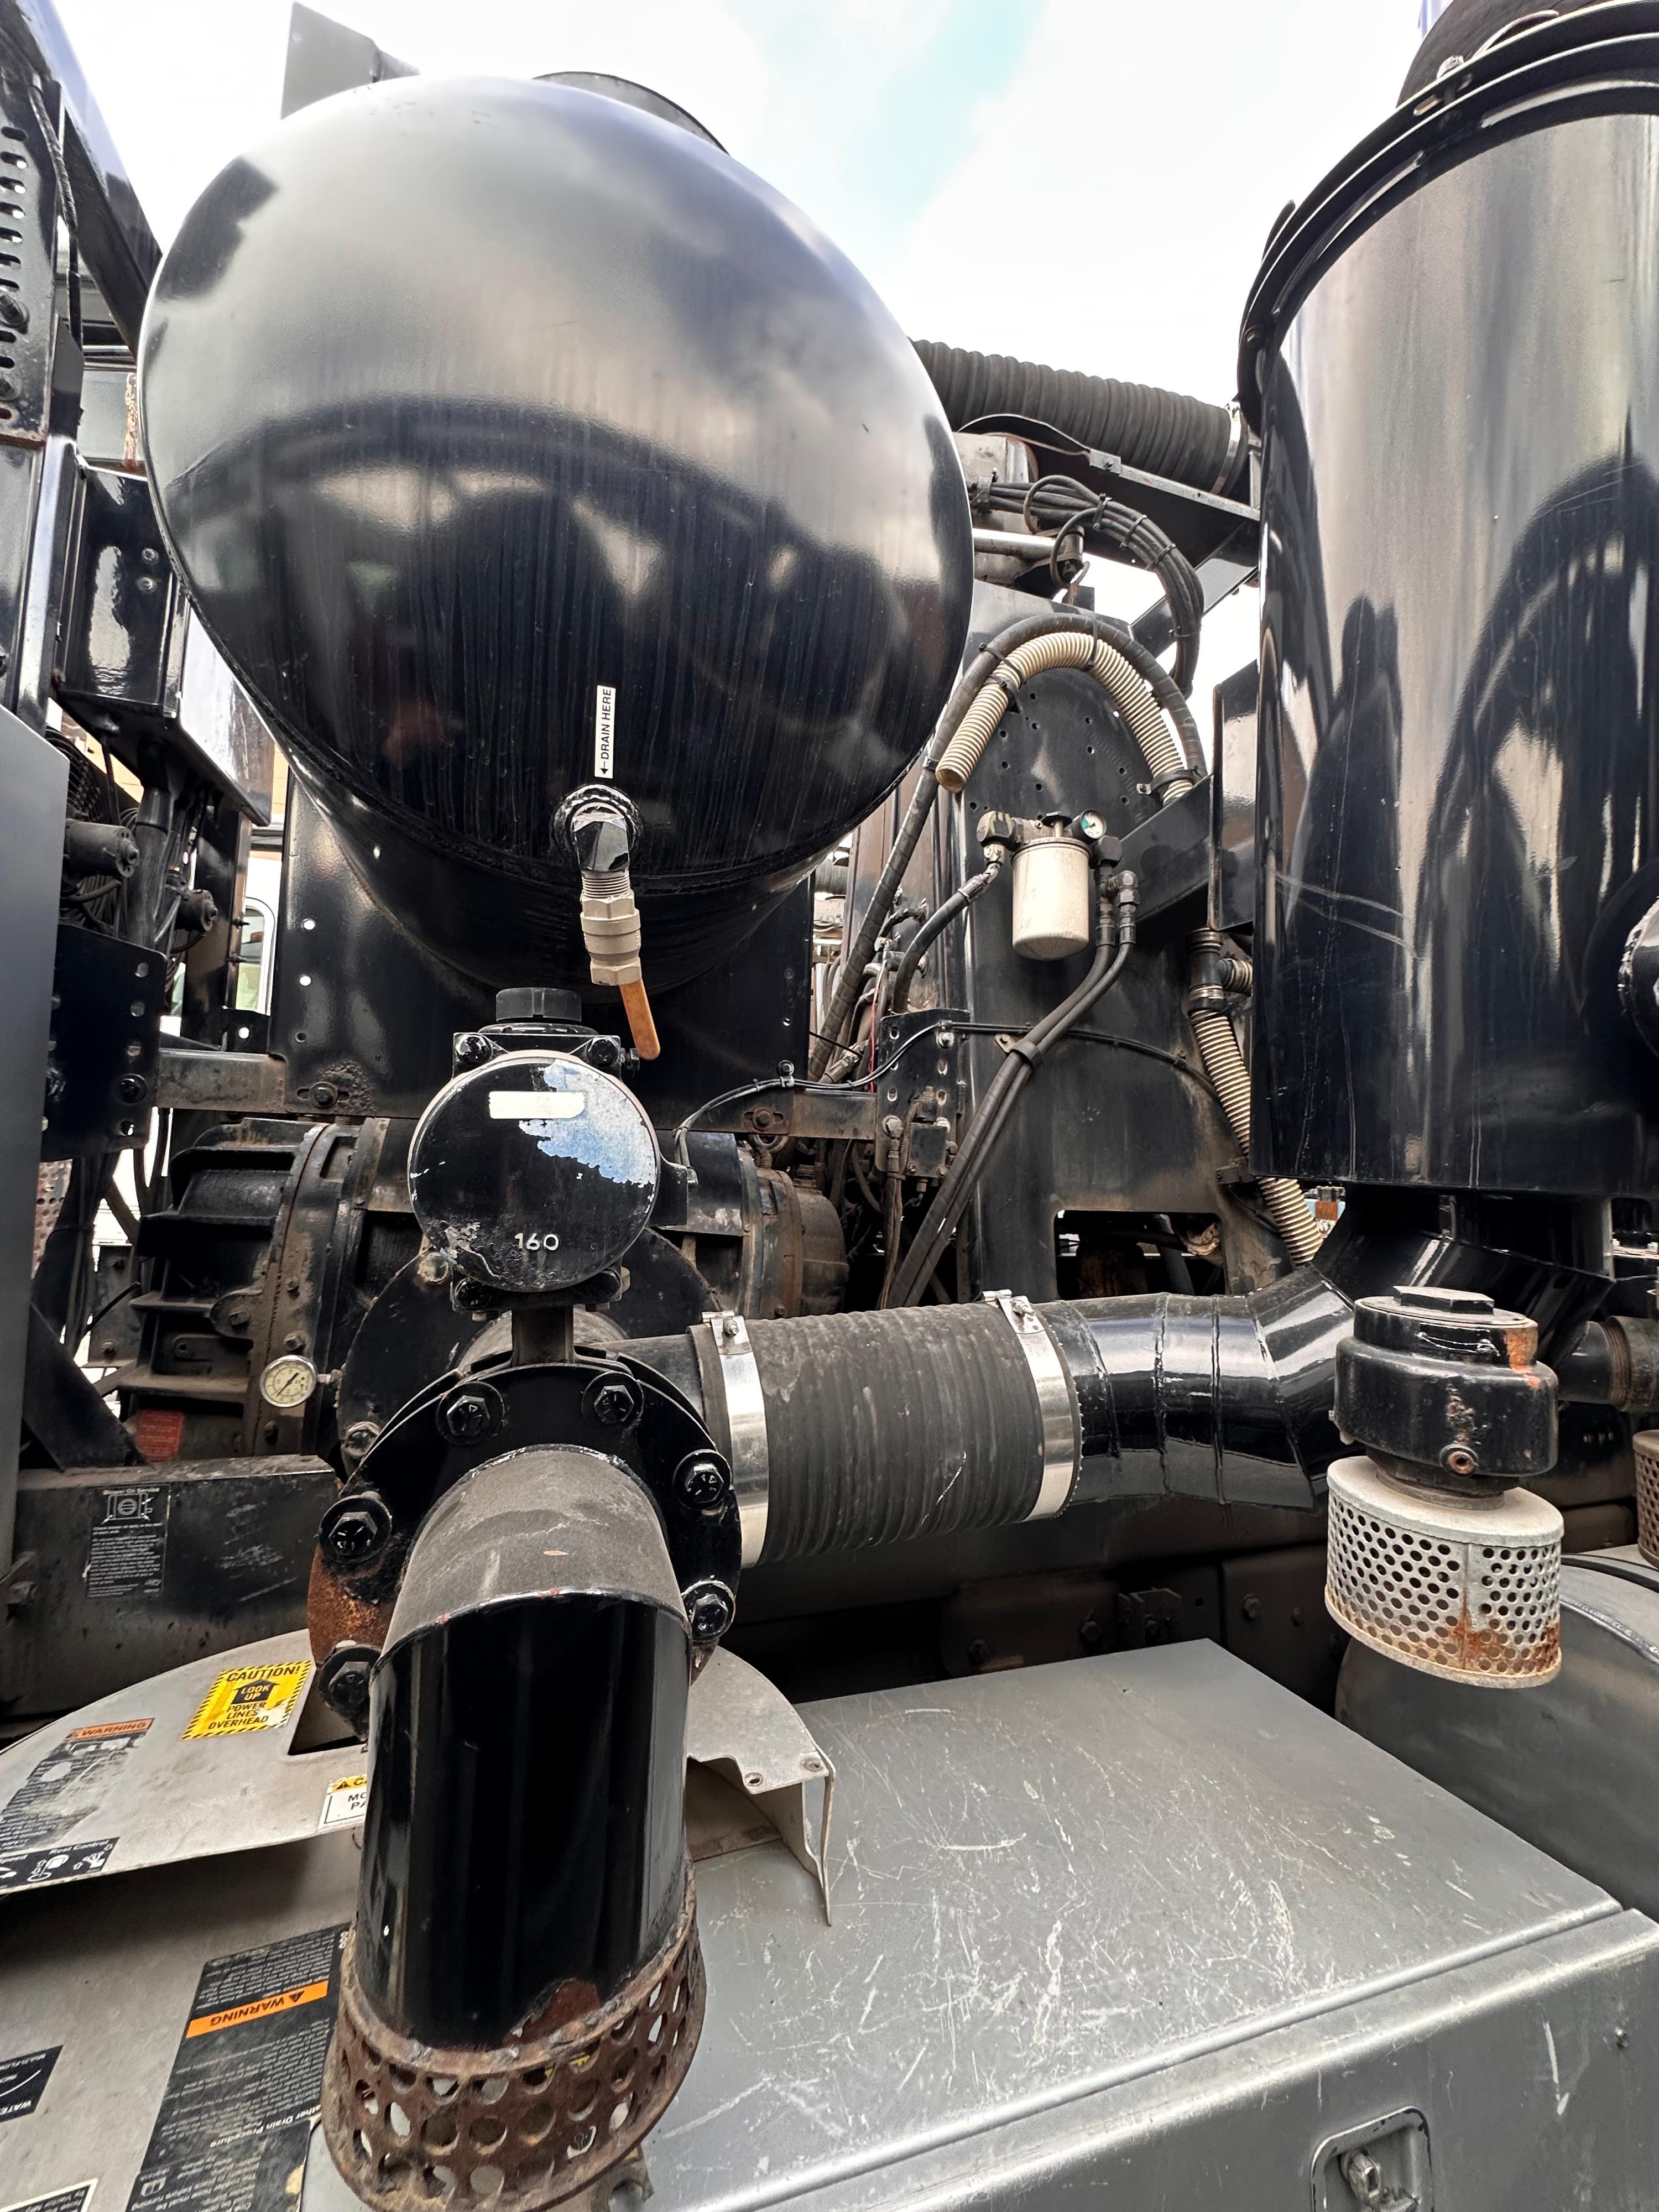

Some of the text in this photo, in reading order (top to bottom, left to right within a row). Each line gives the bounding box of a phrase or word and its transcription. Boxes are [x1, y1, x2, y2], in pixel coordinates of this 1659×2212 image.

[601, 688, 612, 760] DRAIN HERE
[514, 1233, 560, 1251] 160
[226, 1666, 301, 1682] CAUTION!
[241, 1684, 271, 1694] LOOK
[244, 1692, 262, 1701] UP
[226, 1702, 267, 1713] POWER
[227, 1709, 261, 1720] LINES
[83, 1721, 147, 1736] WARNING
[207, 1715, 269, 1730] OVERHEAD
[210, 1997, 285, 2027] WARNING
[0, 2100, 32, 2116] WATE
[210, 2104, 321, 2147] ather Drain Procedure
